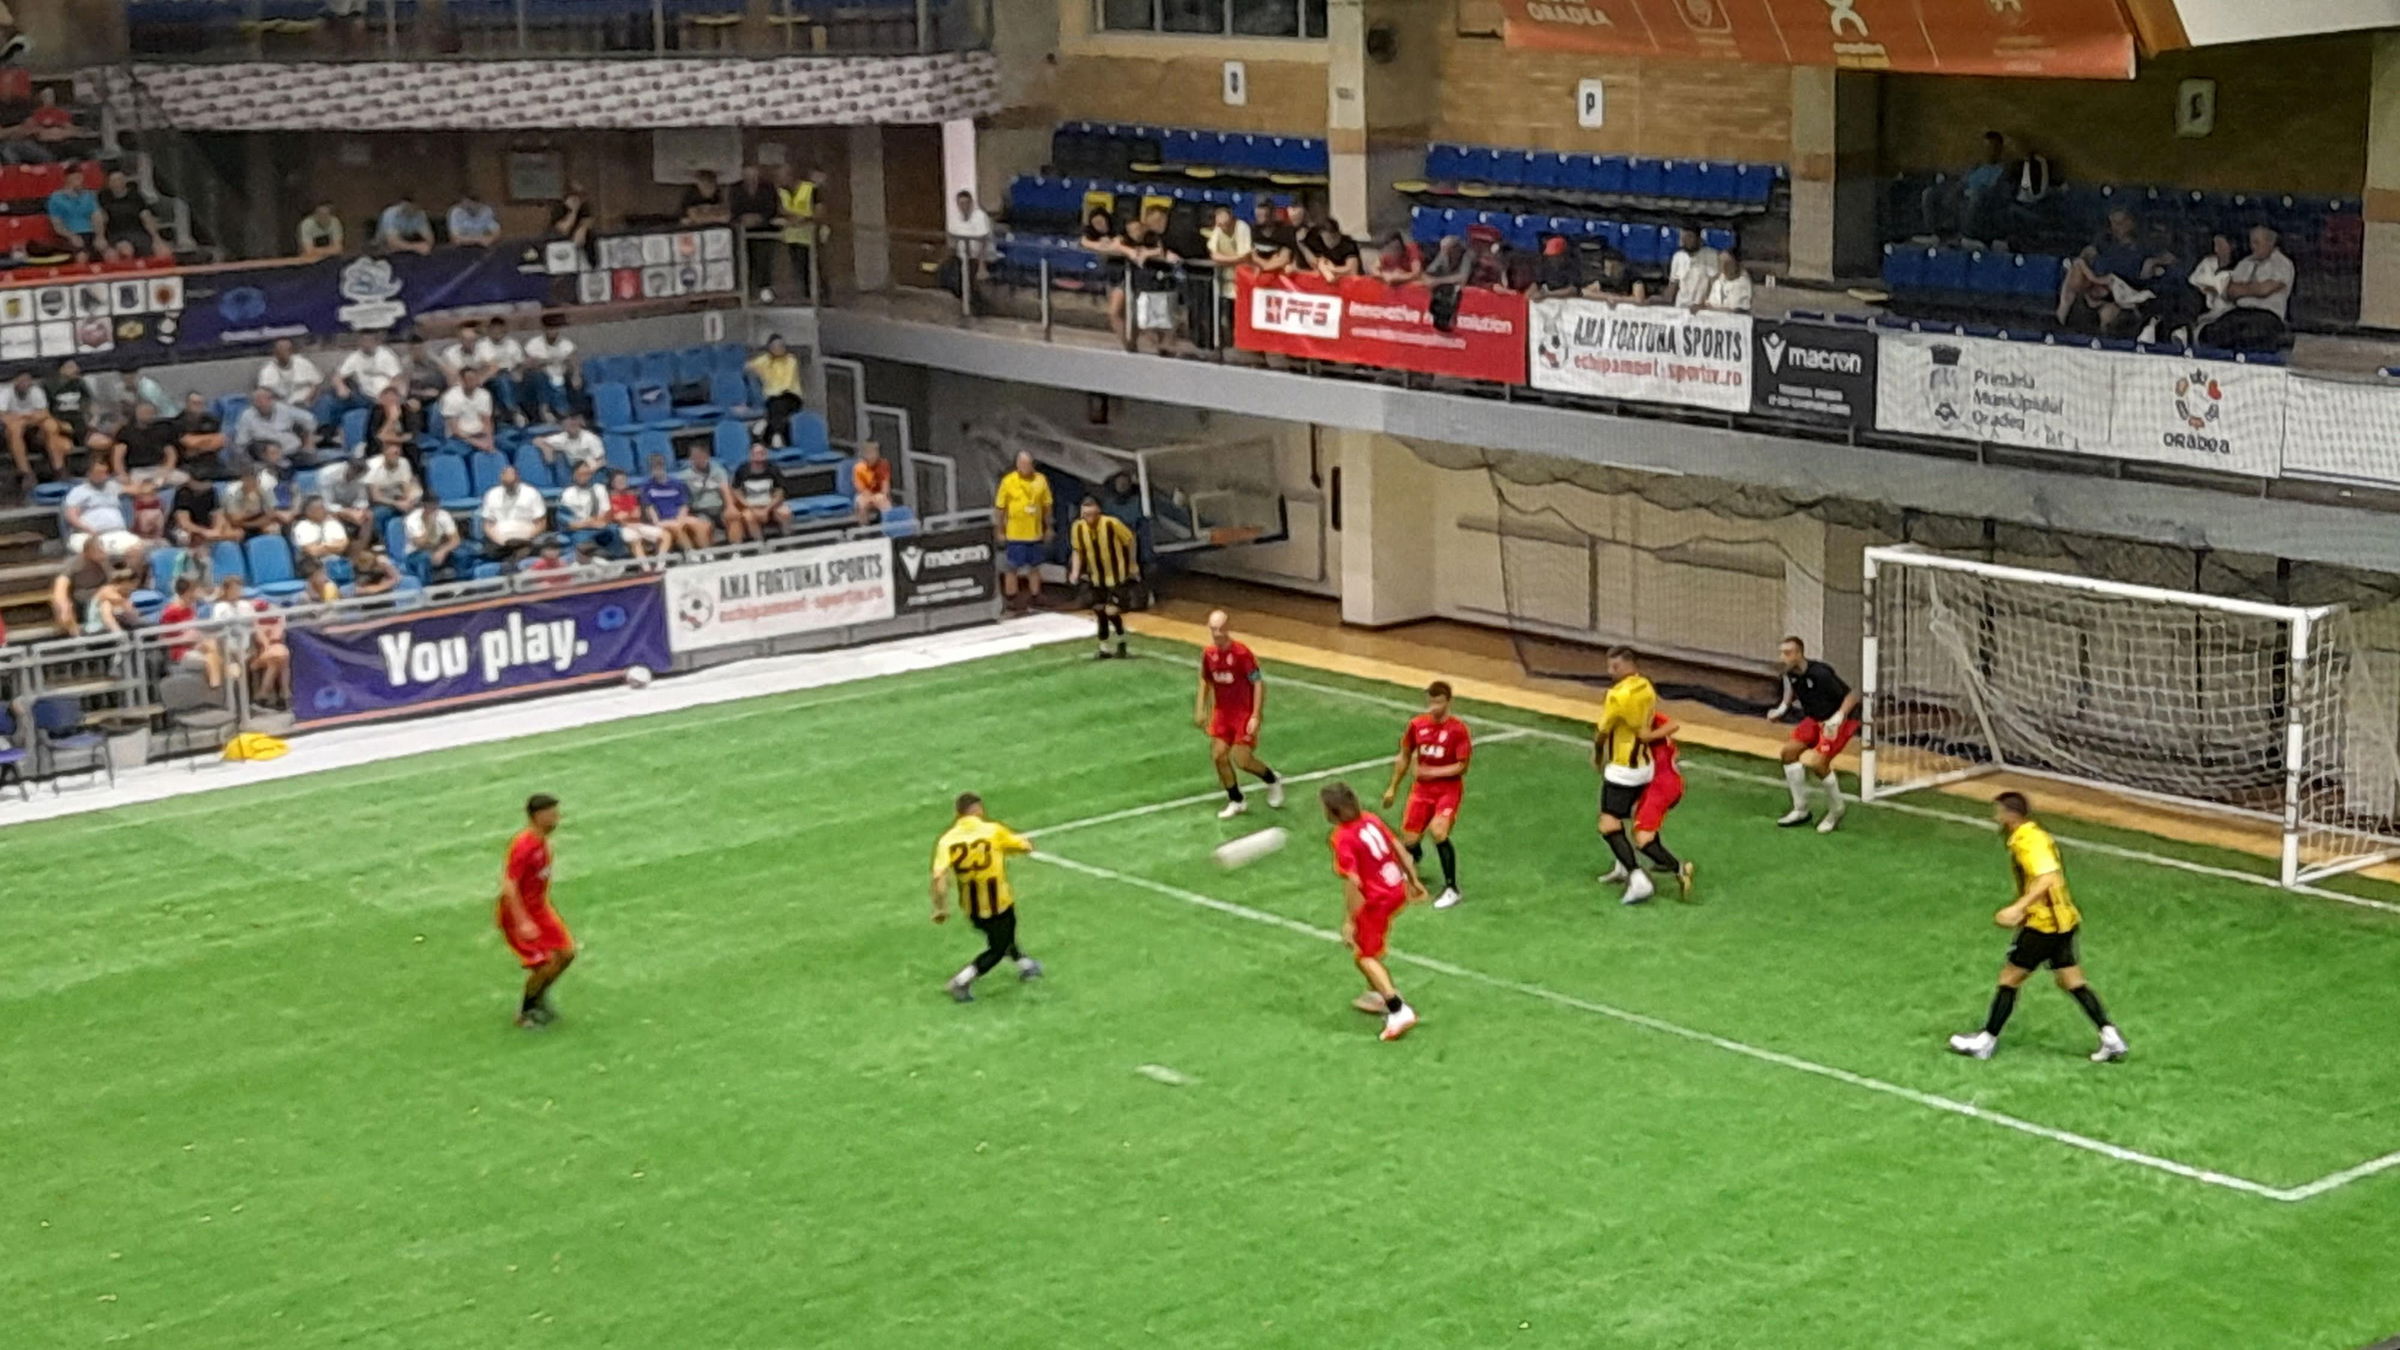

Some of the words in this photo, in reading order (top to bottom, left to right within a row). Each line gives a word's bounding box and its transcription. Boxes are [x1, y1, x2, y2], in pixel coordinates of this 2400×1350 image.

[1585, 91, 1596, 116] P
[1608, 319, 1677, 355] FORTUNA
[1682, 325, 1743, 362] SPORTS
[1788, 346, 1863, 375] macron
[827, 553, 883, 587] SPORTS
[377, 630, 469, 687] You
[480, 610, 589, 683] play.
[948, 837, 992, 875] 23
[1358, 821, 1391, 862] 11
